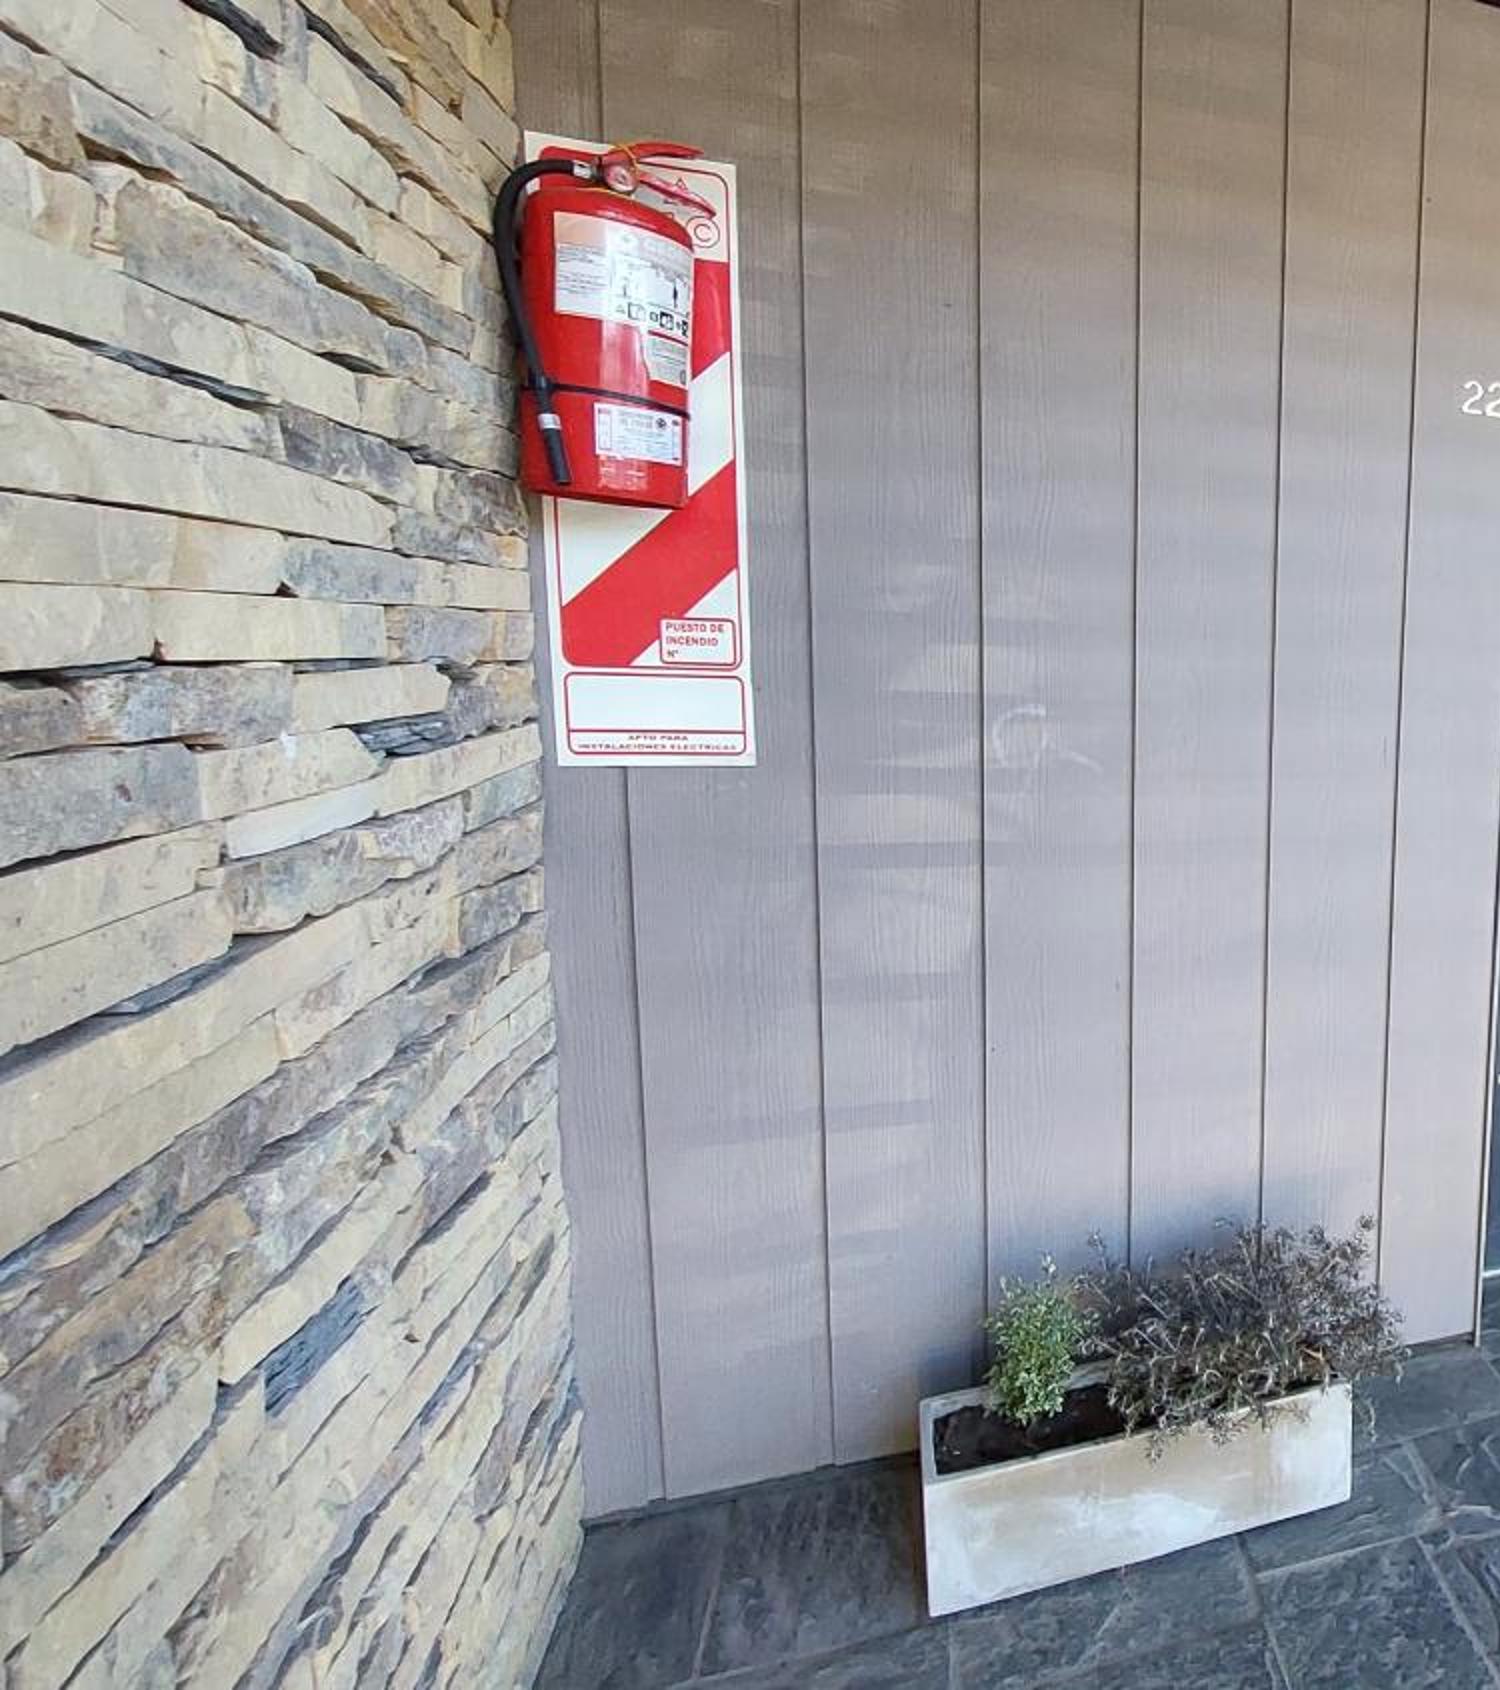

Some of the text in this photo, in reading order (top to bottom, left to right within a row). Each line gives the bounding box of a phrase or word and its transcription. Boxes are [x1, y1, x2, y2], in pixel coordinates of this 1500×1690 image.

[665, 622, 725, 634] PUESTO DE
[665, 636, 719, 647] INCENDIO
